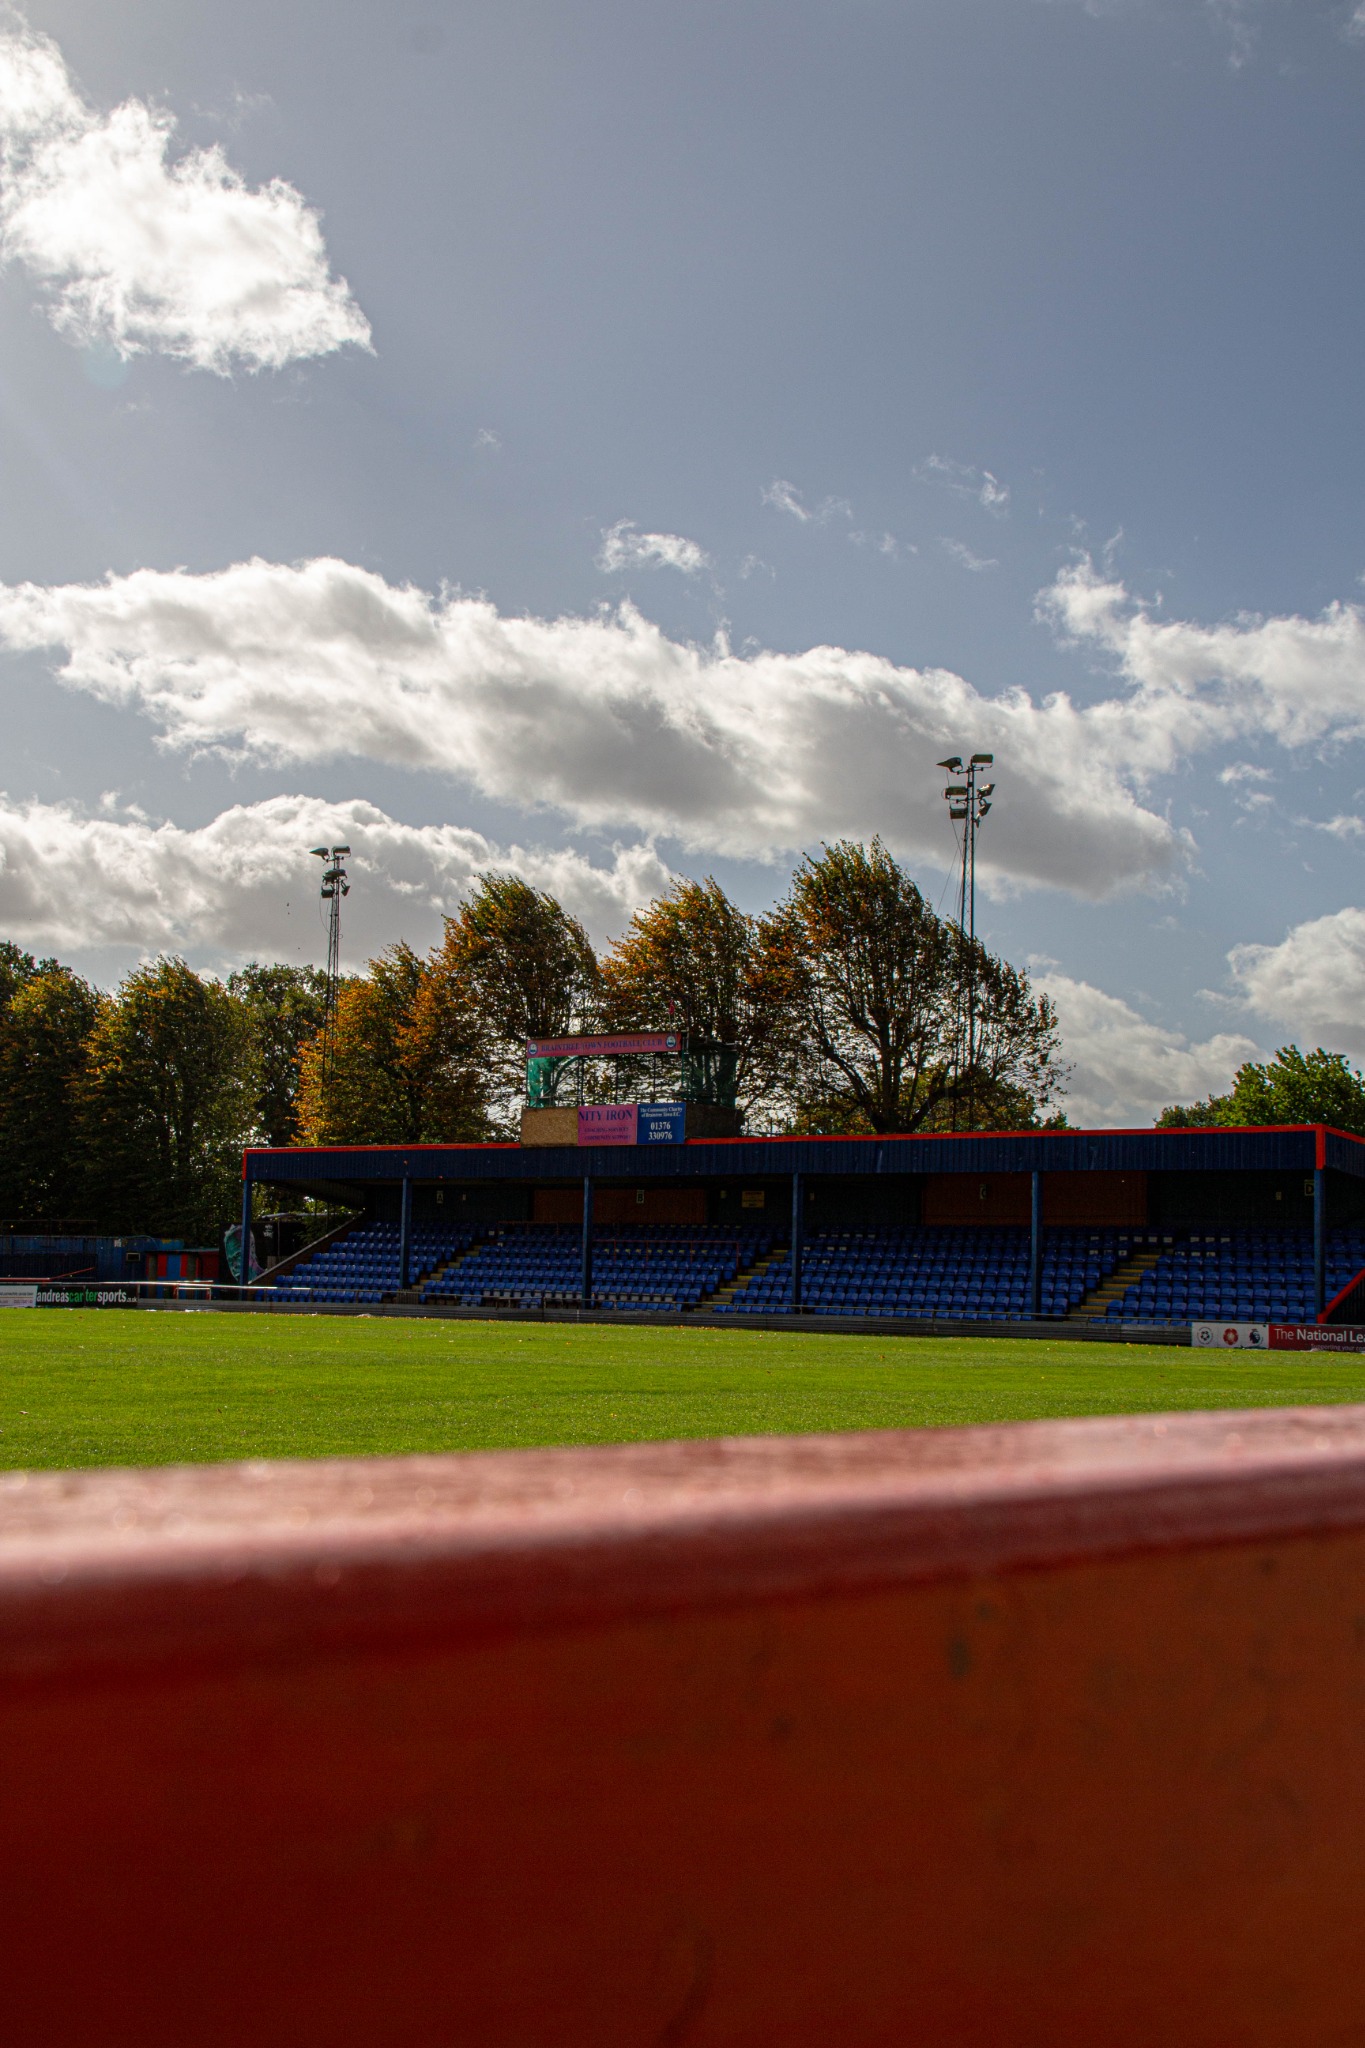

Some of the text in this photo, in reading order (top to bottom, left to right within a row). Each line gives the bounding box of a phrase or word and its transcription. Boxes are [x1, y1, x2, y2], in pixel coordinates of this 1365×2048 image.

[541, 1043, 579, 1052] BRAINTREE
[603, 1040, 641, 1049] FOOTBALL
[642, 1038, 662, 1047] CLUB
[606, 1109, 632, 1120] IRON
[650, 1121, 671, 1131] 01376
[648, 1131, 673, 1141] 330976
[1274, 1328, 1365, 1343] The National Le
